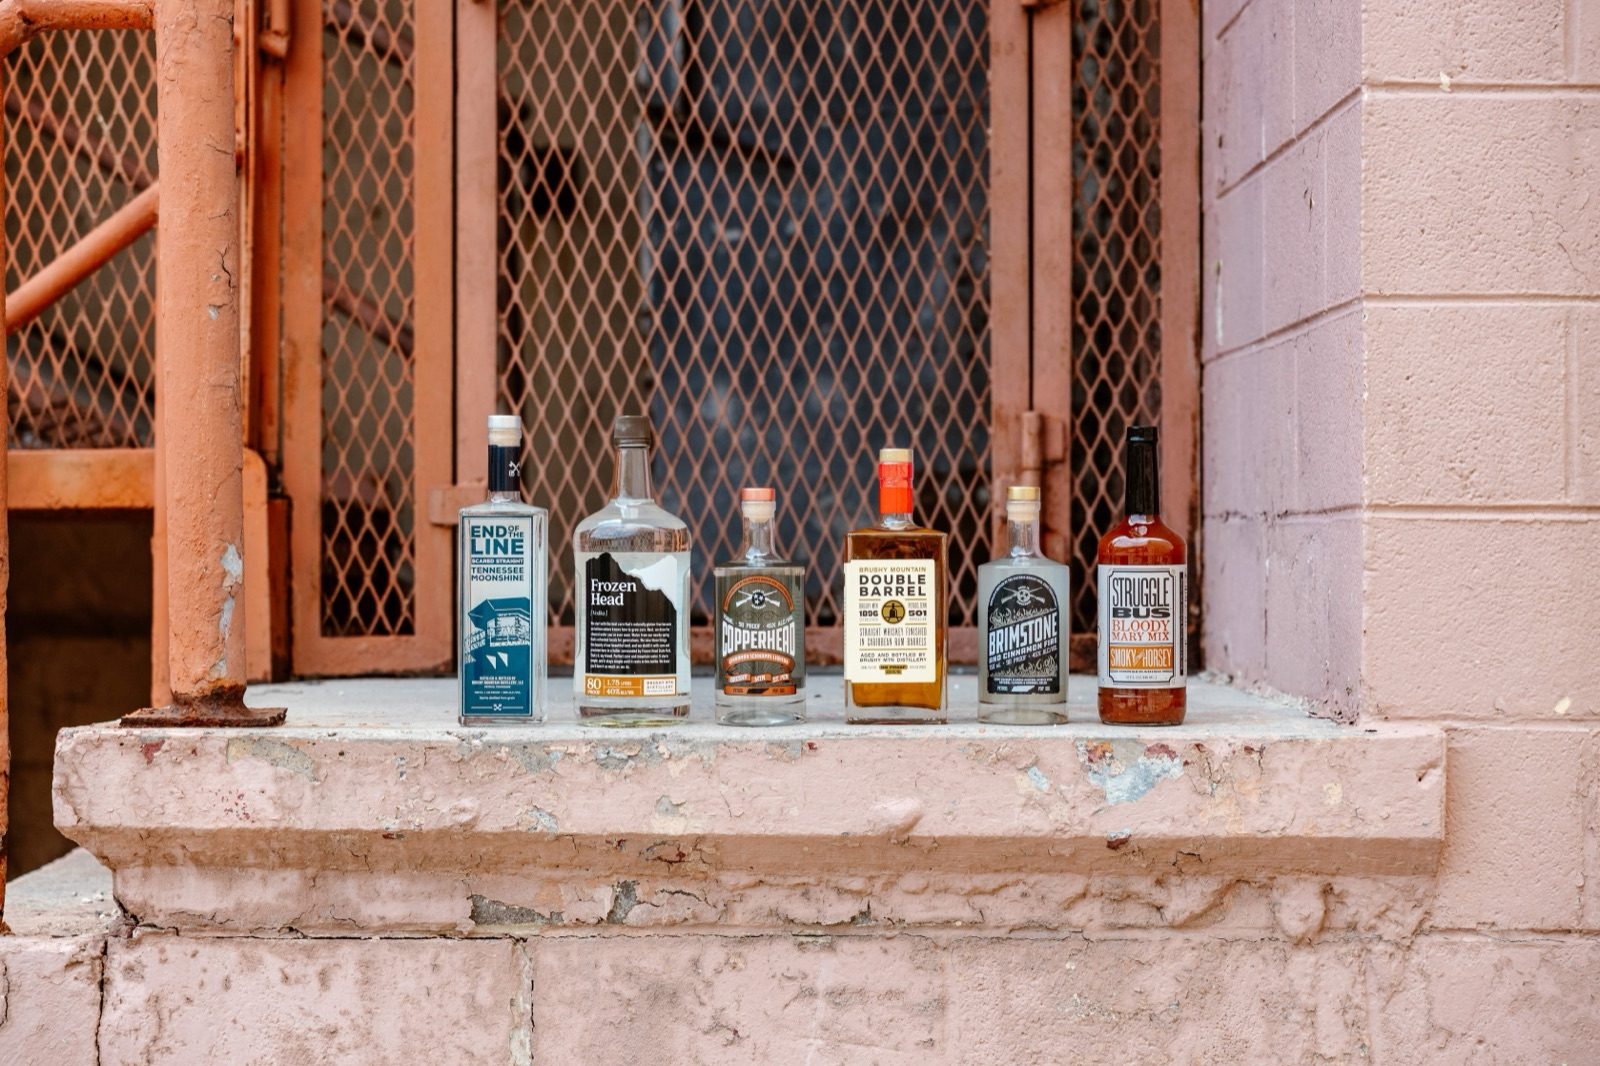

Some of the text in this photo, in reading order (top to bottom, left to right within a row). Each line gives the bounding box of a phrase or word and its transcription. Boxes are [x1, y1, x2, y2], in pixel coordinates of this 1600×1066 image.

[471, 525, 508, 538] END
[471, 538, 524, 555] LINE
[590, 578, 637, 592] Frozen
[860, 574, 926, 585] DOUBLE
[860, 586, 926, 596] BARREL
[1112, 577, 1169, 607] STRUGGLE
[590, 592, 624, 606] Head
[1112, 607, 1170, 618] BUS
[860, 627, 927, 636] STRAIGHT WHISKEY FINISHED
[1112, 620, 1169, 631] BLOODY
[722, 620, 795, 657] COPPERHEAD
[989, 611, 1057, 656] BRIMSTONE
[1112, 632, 1169, 641] MARY MIX
[860, 637, 926, 646] IN CARIBBEAN RUM BARRELS
[989, 637, 1057, 664] AND CINNAMON FIRE
[1013, 655, 1026, 664] PROOF
[1110, 648, 1136, 667] SMOKY
[1142, 648, 1172, 667] HORSEY
[587, 678, 602, 690] 80
